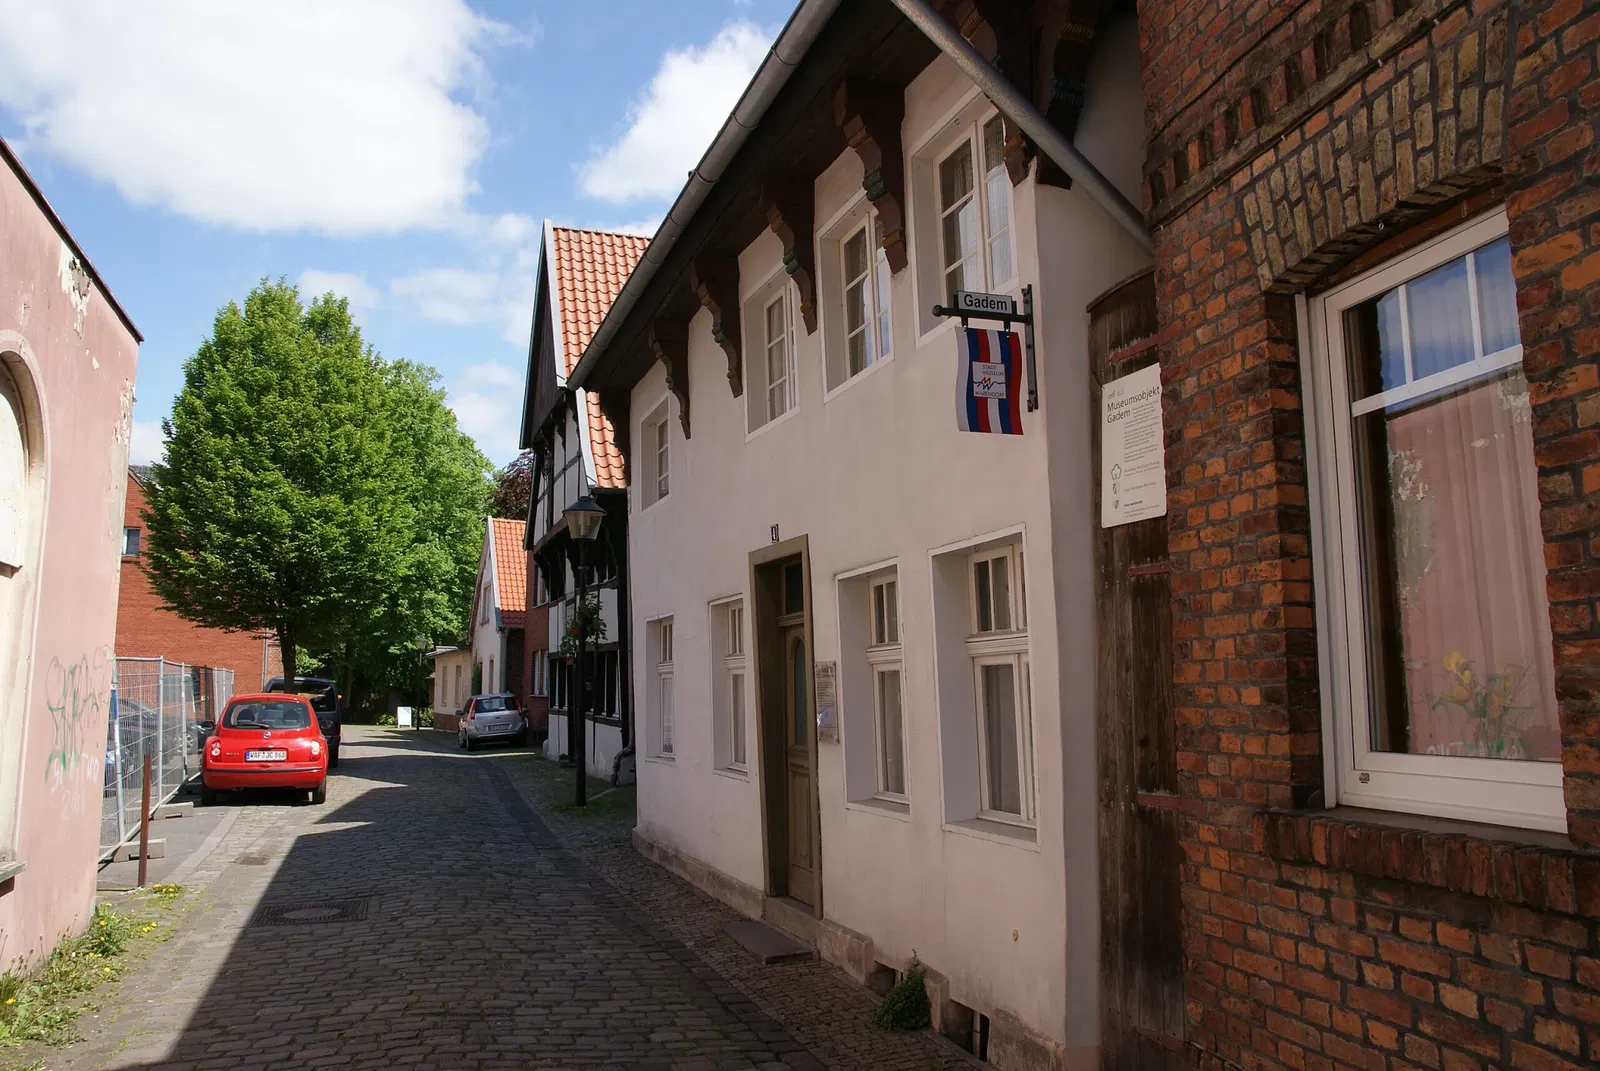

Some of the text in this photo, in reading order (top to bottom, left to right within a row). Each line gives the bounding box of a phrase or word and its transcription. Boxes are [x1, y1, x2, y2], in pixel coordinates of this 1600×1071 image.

[964, 294, 1008, 311] Gadem
[1107, 386, 1160, 412] Museumsobjekt
[1107, 410, 1131, 423] Gadem
[250, 751, 261, 759] WAF
